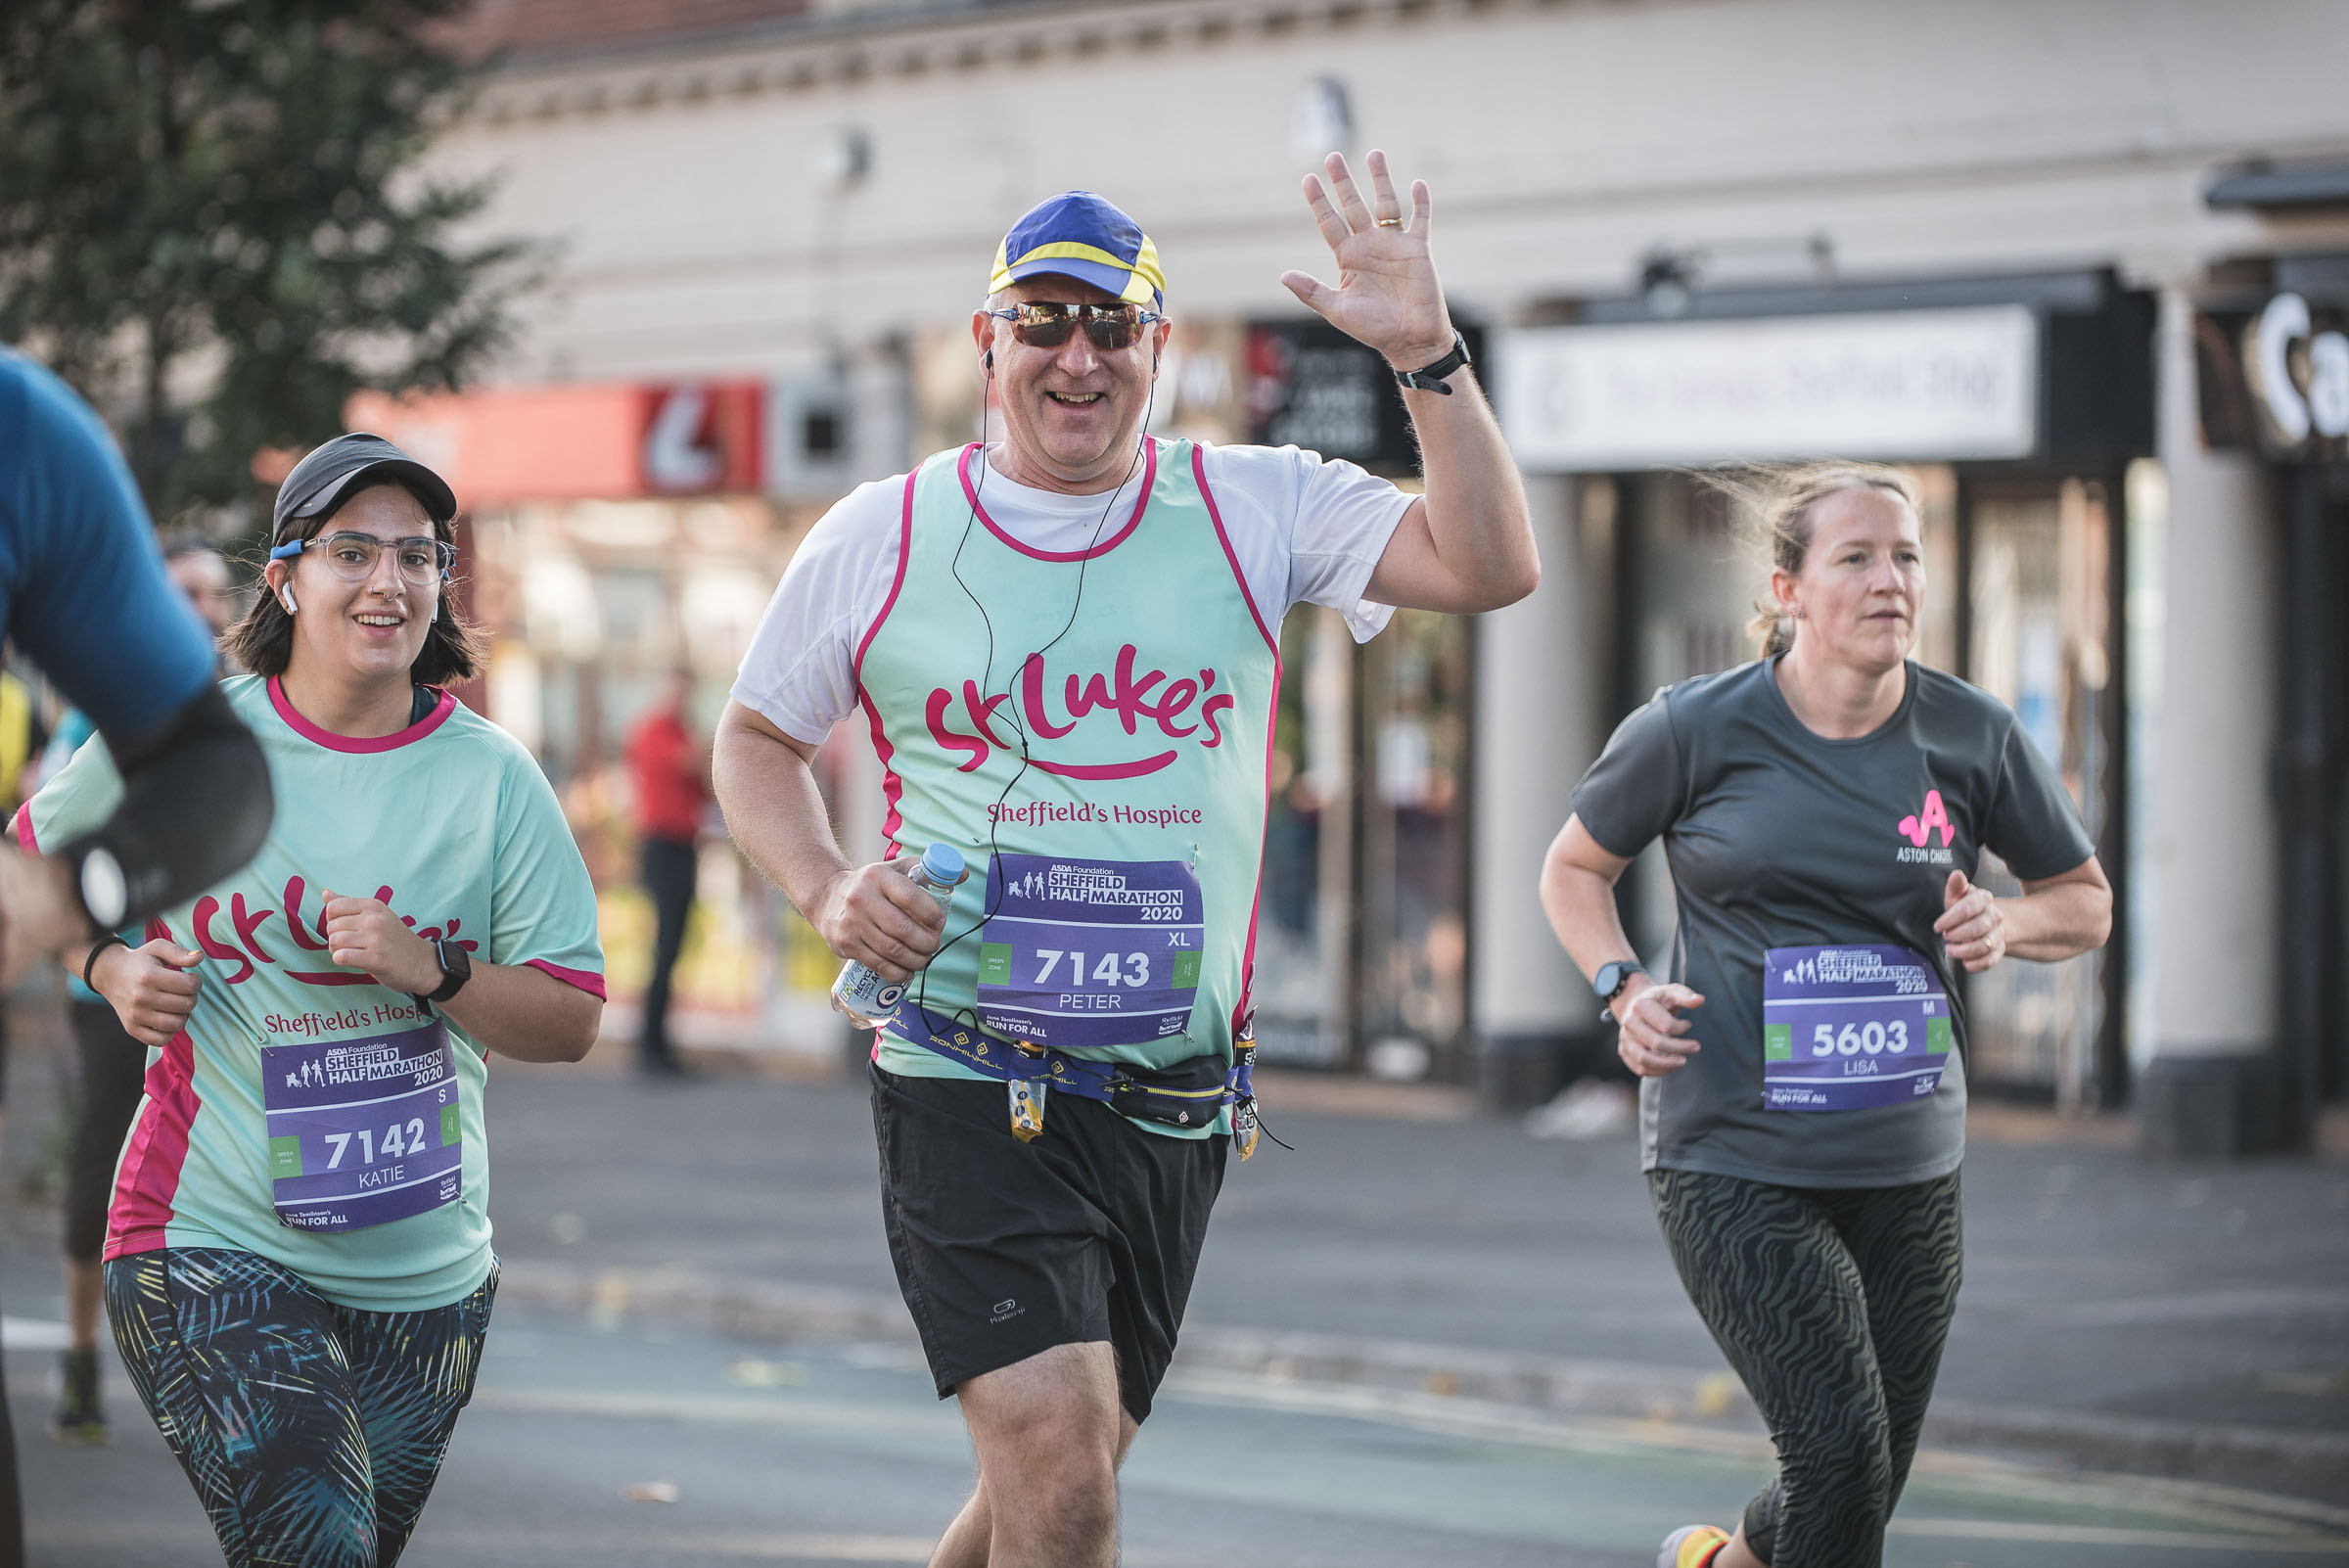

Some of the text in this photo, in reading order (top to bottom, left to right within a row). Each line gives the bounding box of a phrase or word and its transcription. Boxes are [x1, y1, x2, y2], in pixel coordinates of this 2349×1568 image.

[1022, 643, 1234, 748] Luke's
[987, 801, 1203, 829] Sheffield's Hospice
[1896, 846, 1928, 863] ASTON
[1051, 864, 1115, 875] ASDA Foundation
[1049, 872, 1124, 890] SHEFFIELD
[1049, 888, 1182, 904] HALF MARATHON
[1140, 907, 1182, 920] 2020
[1168, 932, 1190, 946] XL
[1034, 949, 1150, 988] 7143
[1818, 954, 1881, 968] SHEFFIELD
[1819, 966, 1925, 983] HALF MARATHON
[1896, 980, 1928, 993] 2020
[1059, 993, 1122, 1009] PETER
[1922, 1000, 1935, 1015] M
[264, 1002, 425, 1038] Sheffield's Hosp
[986, 1019, 1047, 1038] RUN FOR ALL
[1812, 1019, 1909, 1057] 5603
[326, 1042, 388, 1057] ASDA Foundation
[326, 1047, 399, 1072] SHEFFIELD
[328, 1049, 443, 1084] HALF MARATHON
[1844, 1059, 1878, 1076] LISA
[414, 1065, 443, 1086] 2020
[438, 1088, 447, 1103] S
[324, 1117, 427, 1170] 7142
[358, 1165, 405, 1189] KATIE
[307, 1217, 328, 1225] FOR
[330, 1214, 348, 1224] ALL
